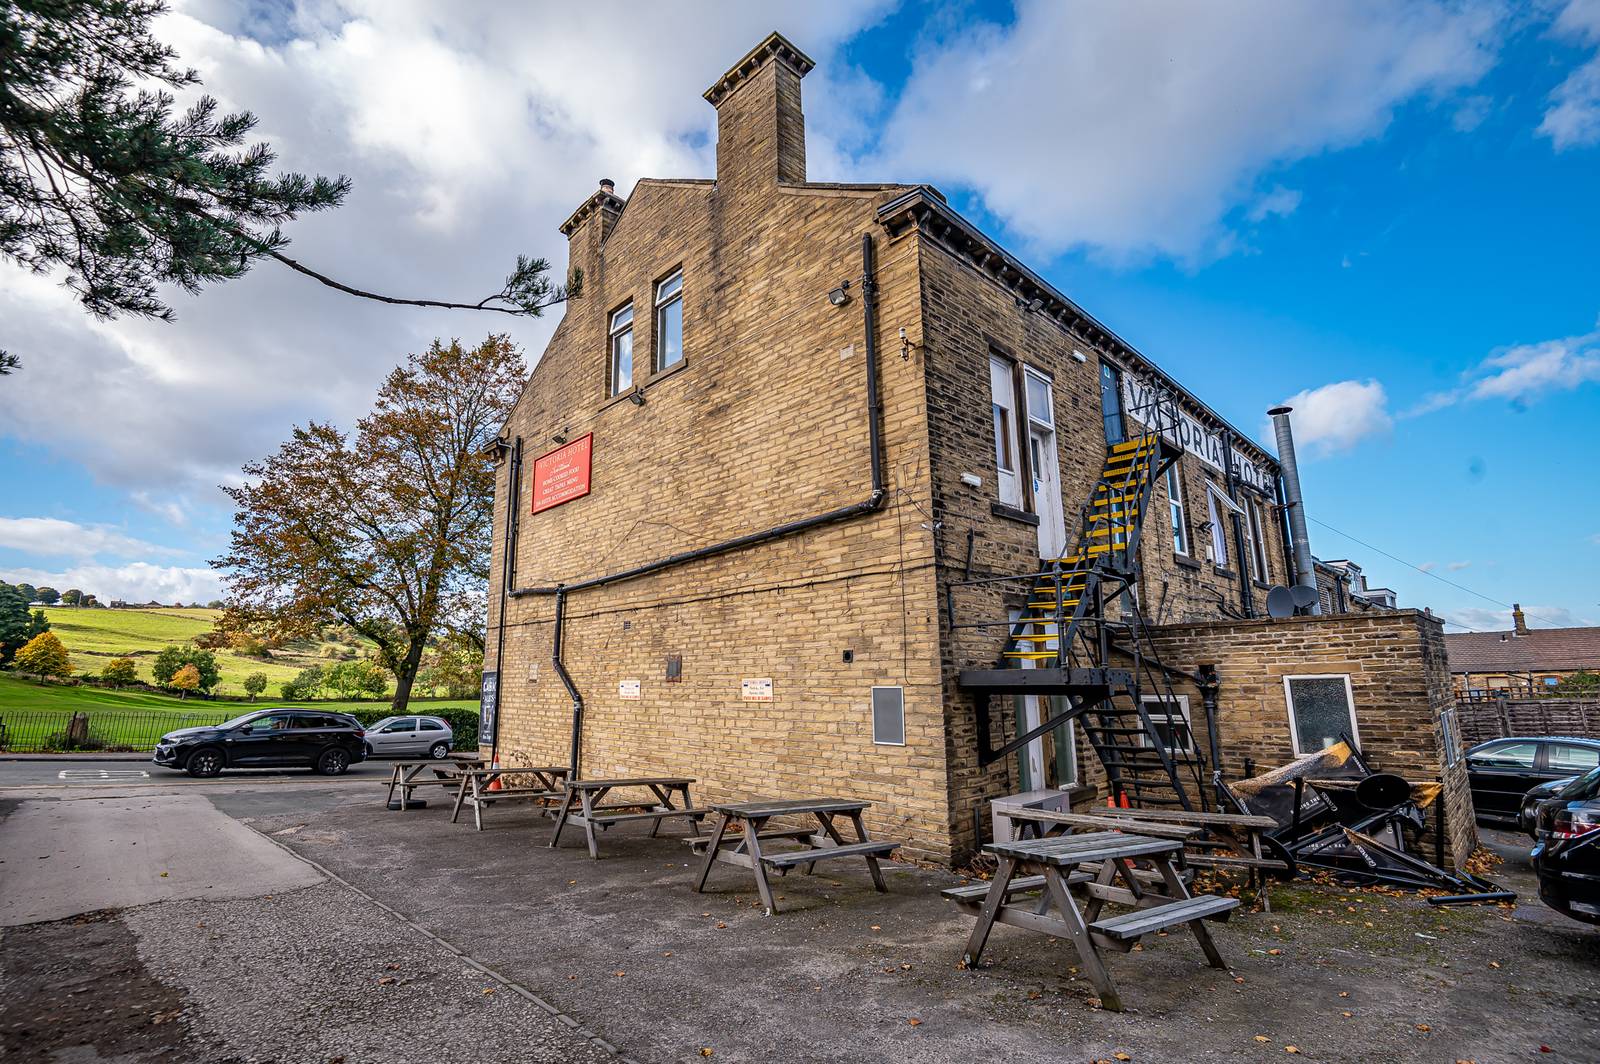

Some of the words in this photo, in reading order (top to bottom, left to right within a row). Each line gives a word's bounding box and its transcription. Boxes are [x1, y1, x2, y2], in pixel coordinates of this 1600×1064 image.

[538, 452, 567, 469] VICTORIA
[568, 441, 588, 457] HOTEL
[1232, 452, 1275, 492] HOT
